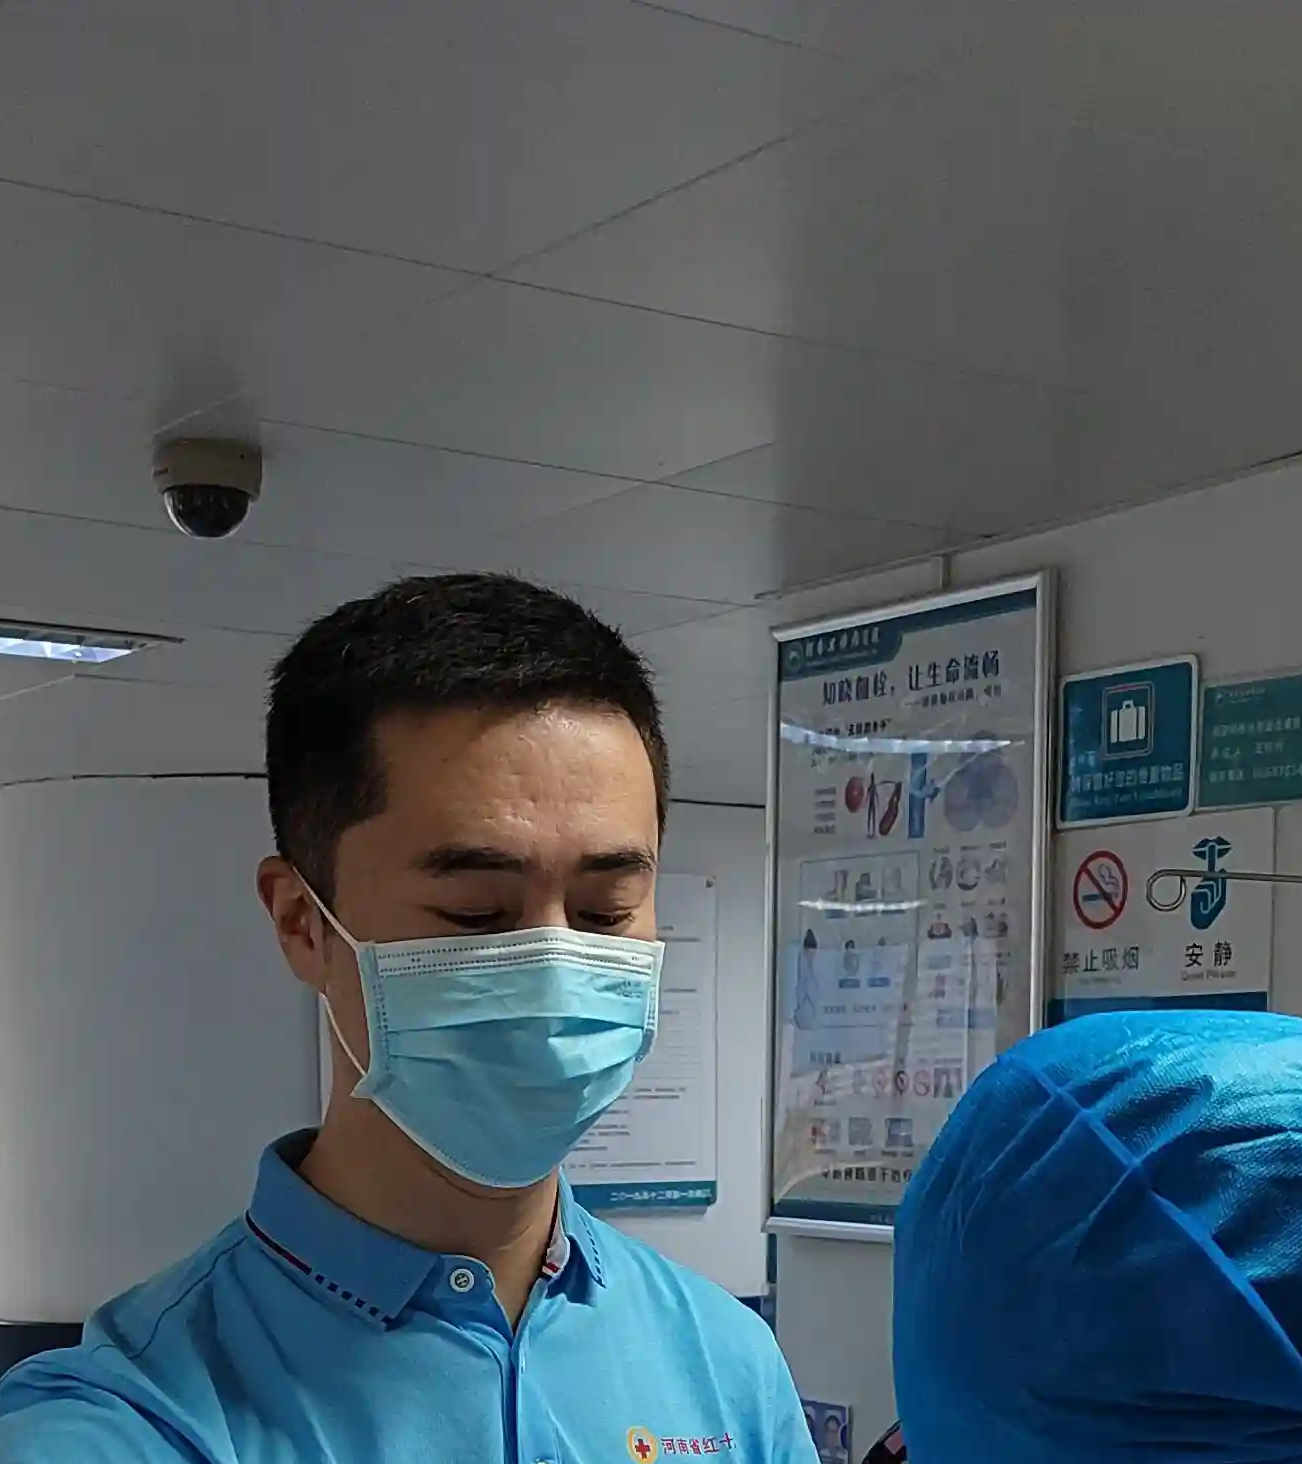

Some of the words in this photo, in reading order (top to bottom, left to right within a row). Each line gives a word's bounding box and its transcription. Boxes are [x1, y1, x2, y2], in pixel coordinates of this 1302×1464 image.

[1062, 946, 1139, 975] 禁止吸烟
[1185, 941, 1234, 968] 安静
[661, 1432, 734, 1456] 河南省红十
